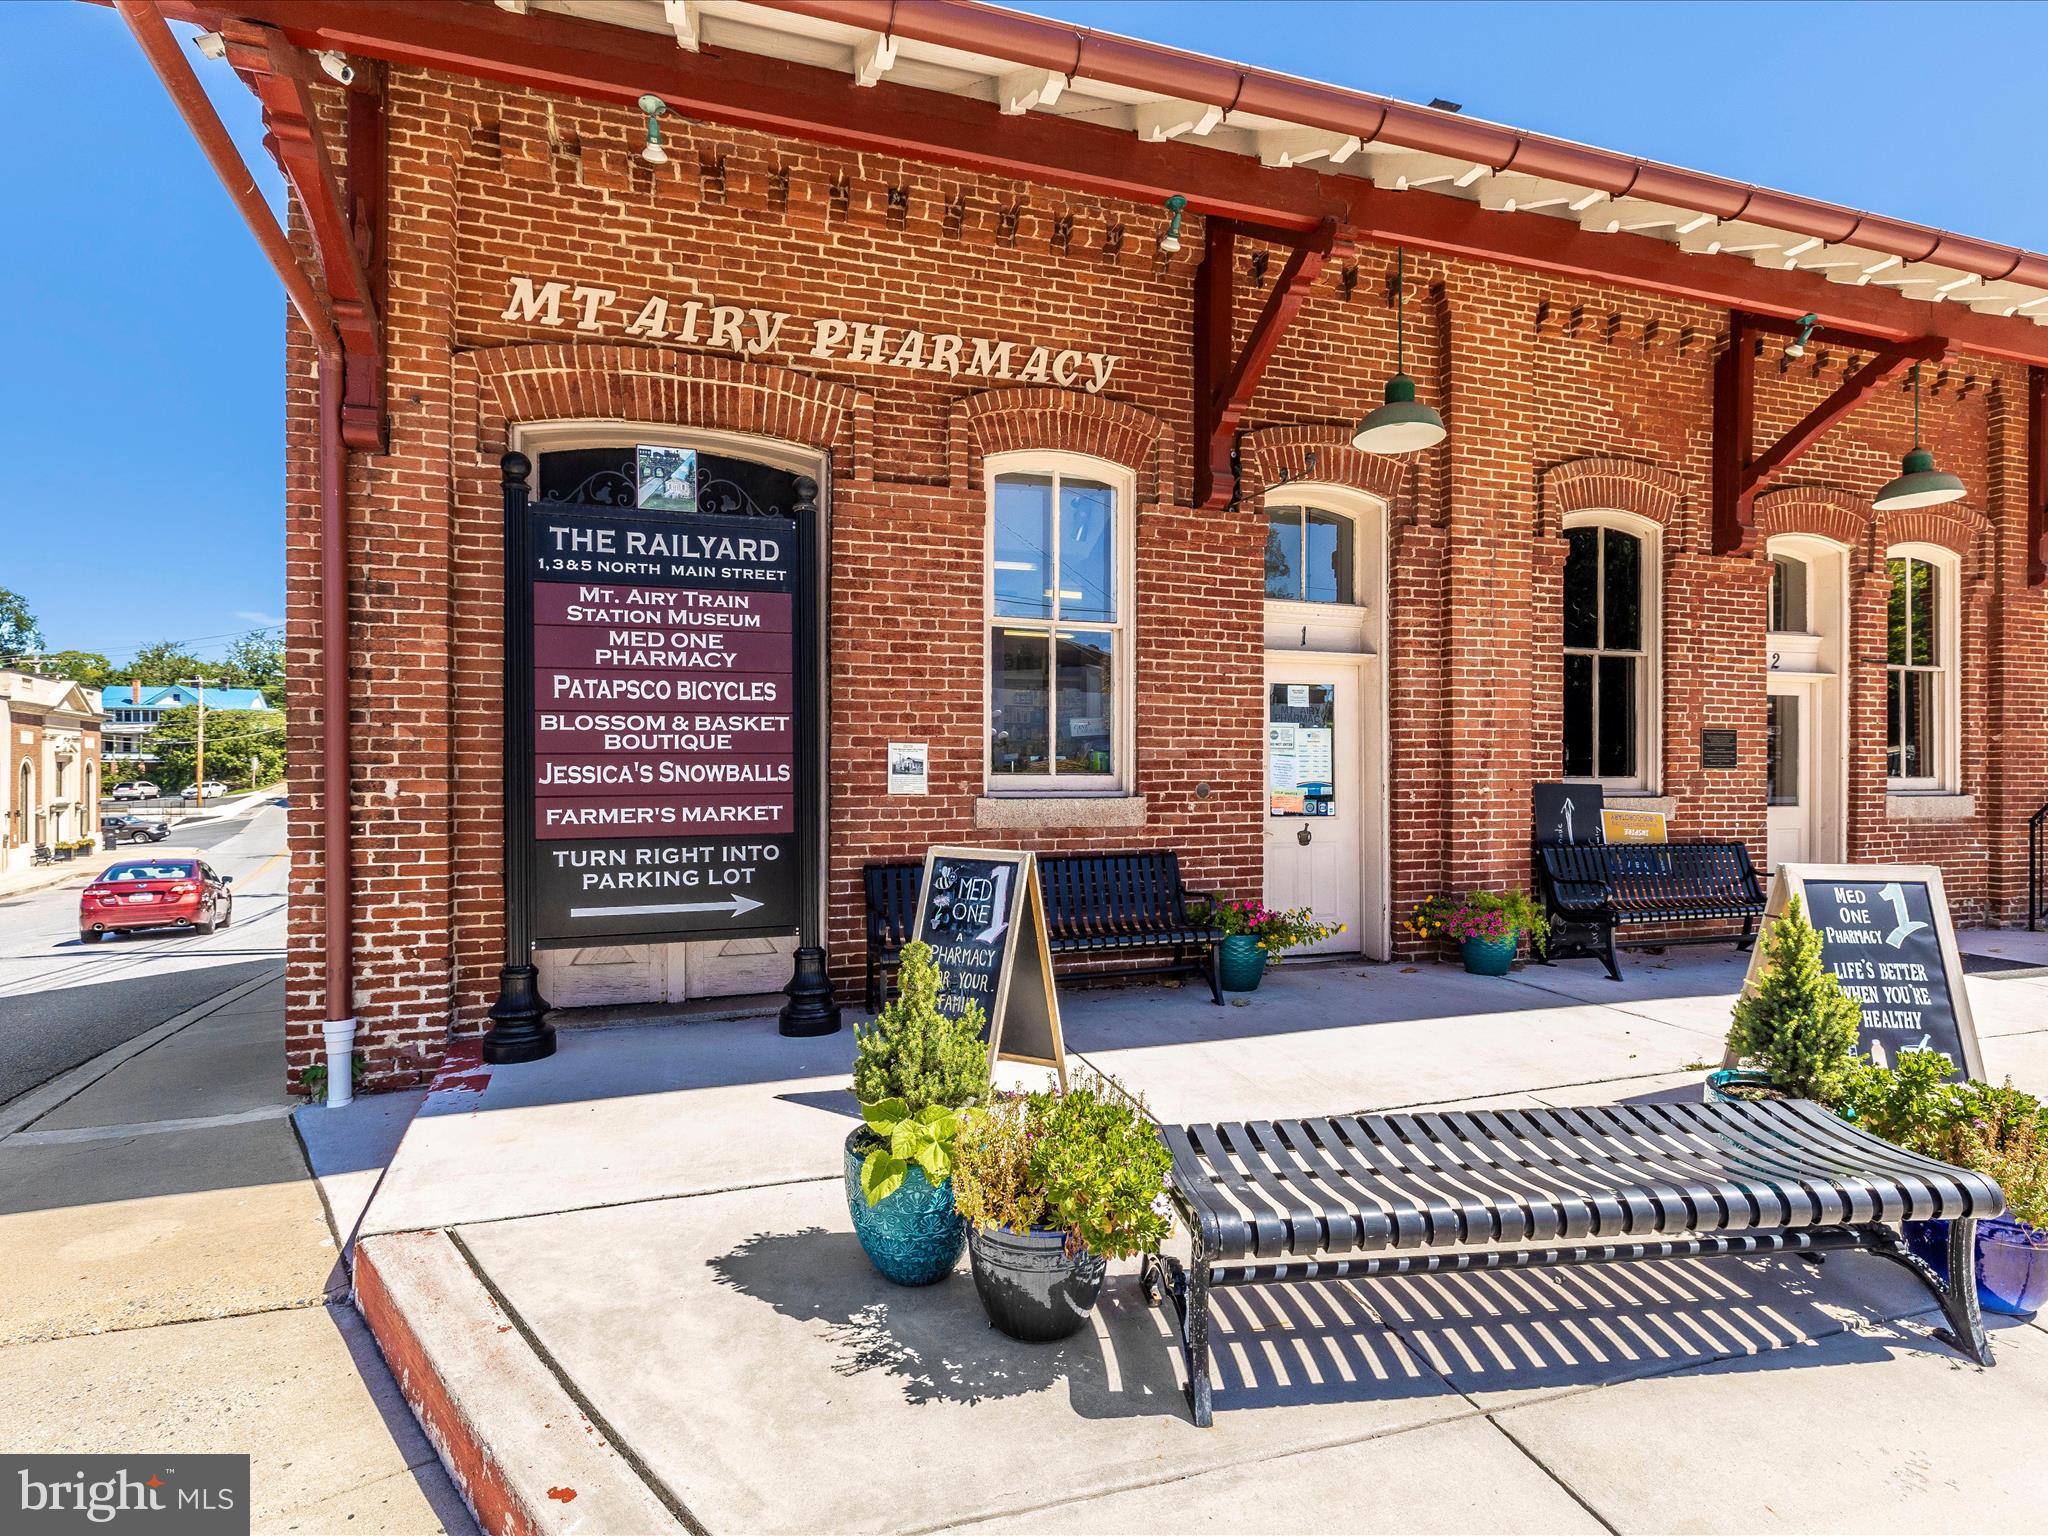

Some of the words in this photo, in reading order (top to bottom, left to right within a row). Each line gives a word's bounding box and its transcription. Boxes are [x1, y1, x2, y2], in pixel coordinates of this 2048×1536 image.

[501, 277, 616, 331] MT
[627, 296, 792, 355] AIRY
[810, 318, 1121, 394] PHARMACY
[550, 526, 615, 553] THE
[626, 532, 779, 562] RAILYARD
[598, 561, 660, 574] NORTH
[672, 565, 715, 577] MAIN
[722, 568, 786, 580] STREET
[626, 589, 678, 605] AIRY
[683, 591, 749, 608] TRAIN
[567, 604, 663, 623] STATION
[668, 609, 760, 627] MUSEUM
[609, 631, 664, 647] MED
[671, 633, 723, 649] ONE
[1300, 626, 1306, 647] 1
[596, 647, 737, 667] PHARMACY
[1771, 653, 1780, 669] 2
[554, 675, 671, 699] PATAPSCO
[677, 681, 776, 701] BICYCLES
[541, 715, 665, 731] BLOSSOM
[672, 716, 689, 731] &
[695, 716, 789, 731] BASKET
[604, 734, 732, 751] BOUTIQUE
[539, 762, 653, 784] JESSICA'S
[659, 761, 790, 782] SNOWBALLS
[547, 808, 675, 825] FARMER'S
[682, 805, 783, 822] MARKET
[553, 850, 625, 867] TURN
[636, 847, 714, 864] RIGHT
[723, 845, 779, 861] INTO
[583, 870, 699, 889] PARKING
[709, 868, 755, 884] LOT
[958, 877, 992, 901] MED
[1834, 887, 1866, 904] MED
[952, 902, 991, 924] ONE
[1840, 907, 1871, 924] ONE
[955, 933, 963, 942] A
[1826, 926, 1882, 945] PHARMACY
[932, 944, 996, 967] PHARMACY
[1833, 959, 1875, 980] LIFE'S
[1878, 962, 1929, 982] BETTER
[1882, 984, 1932, 1006] YOU'RE
[1862, 1010, 1921, 1030] HEALTHY
